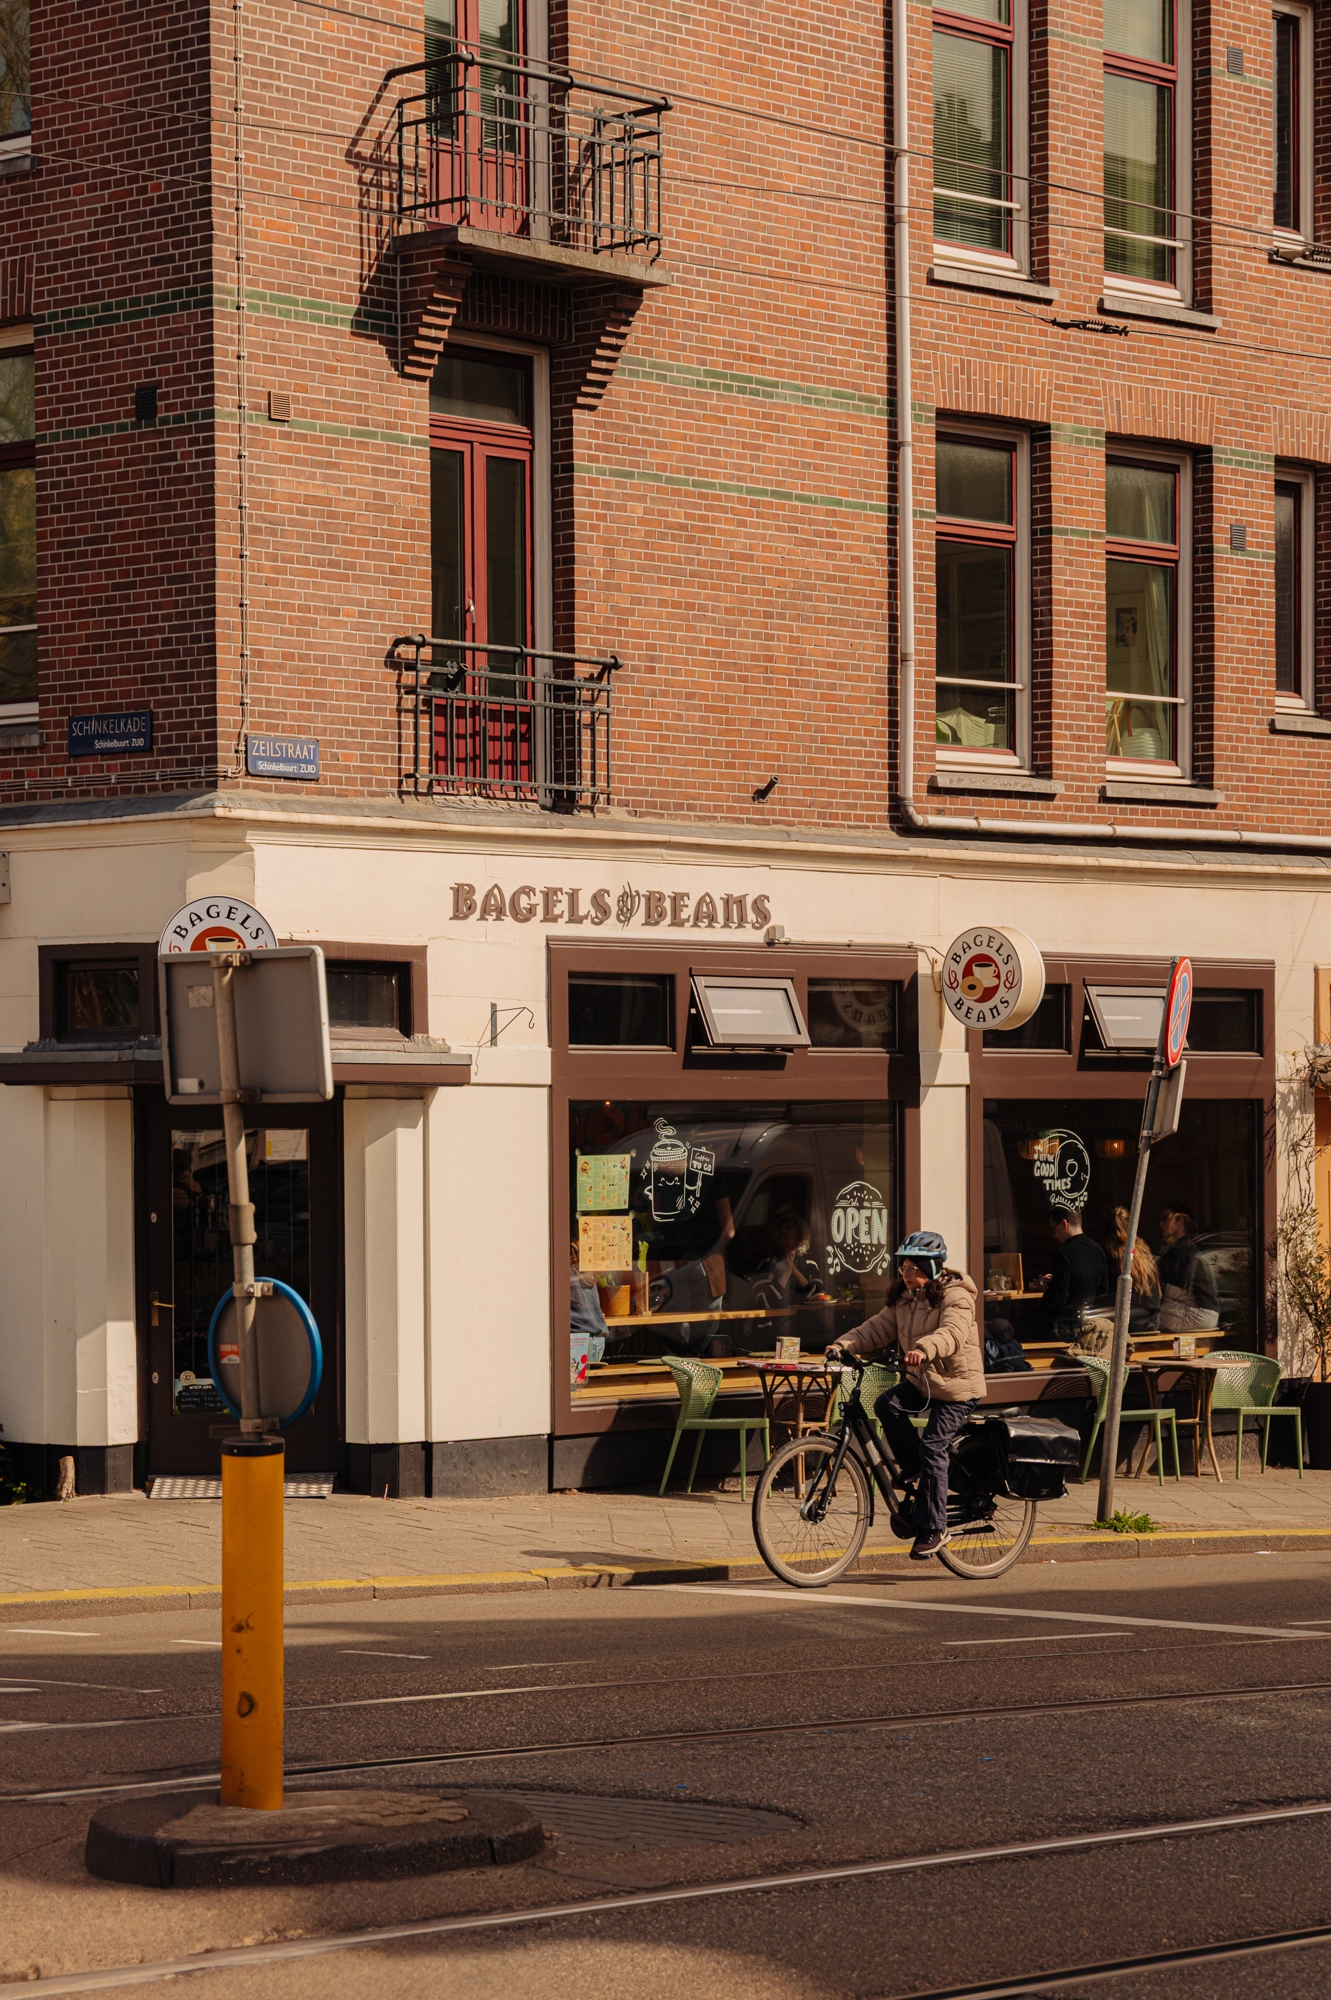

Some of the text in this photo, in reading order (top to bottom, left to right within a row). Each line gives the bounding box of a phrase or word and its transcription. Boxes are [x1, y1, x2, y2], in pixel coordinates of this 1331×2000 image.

[71, 716, 146, 737] SCHINKELKADE
[94, 739, 129, 749] Schinkelbuurt
[251, 740, 316, 760] ZEILSTRAAT
[258, 760, 316, 774] Schinkelbuurt ZUID
[450, 882, 612, 925] BAGELS
[643, 890, 772, 929] BEANS
[172, 904, 265, 941] BAGELS
[951, 934, 1013, 966] BAGELS
[953, 996, 1010, 1023] BEANS
[693, 1161, 712, 1172] TO GO
[695, 1152, 710, 1162] Coffee
[1034, 1160, 1055, 1177] GOOD
[1043, 1177, 1072, 1191] TIMES
[831, 1207, 888, 1245] OPEN
